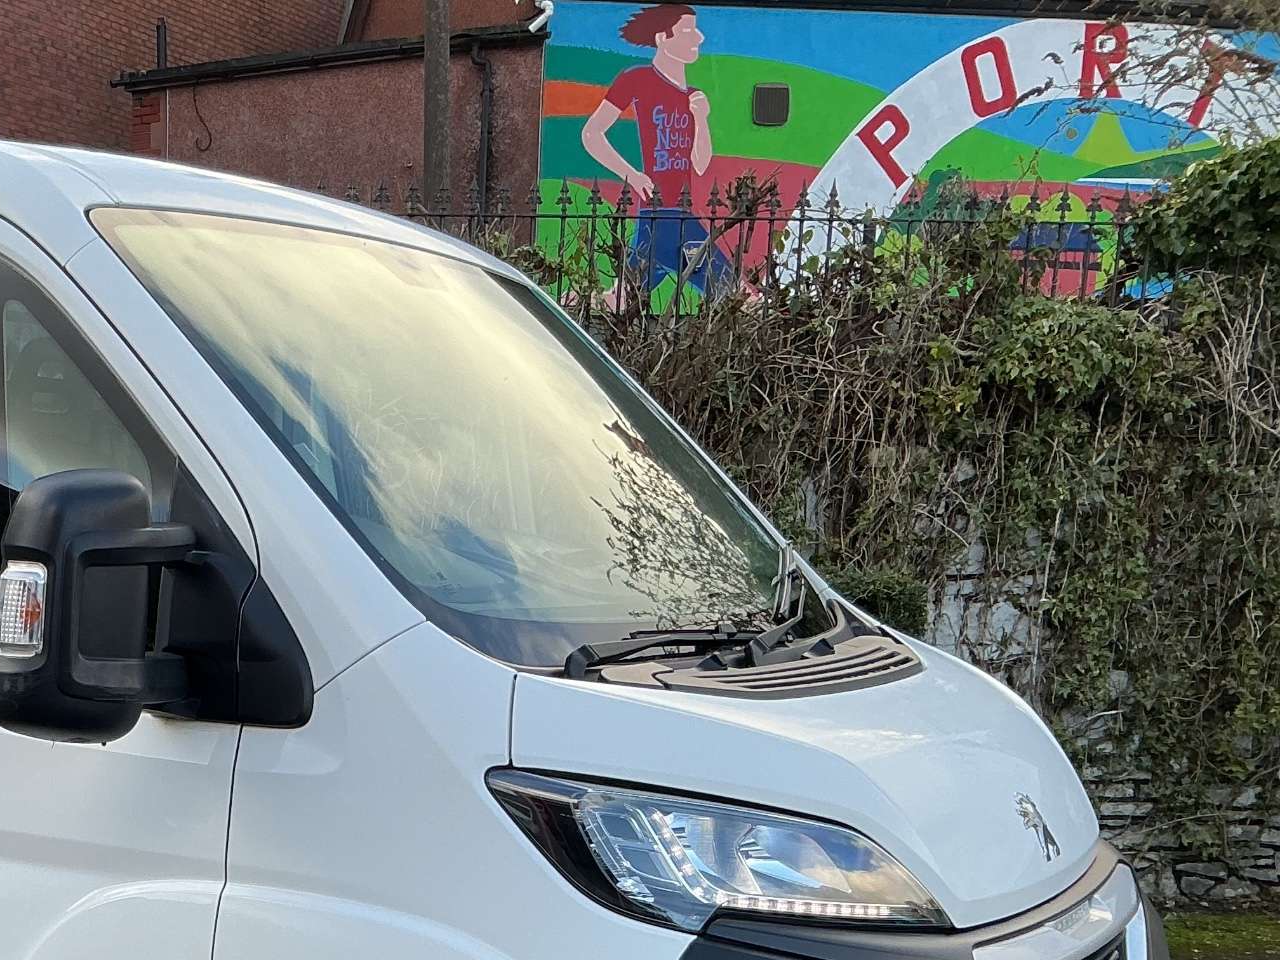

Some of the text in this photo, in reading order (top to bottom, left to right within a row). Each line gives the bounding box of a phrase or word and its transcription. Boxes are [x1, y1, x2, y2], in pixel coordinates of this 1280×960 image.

[652, 104, 689, 130] Guto
[654, 127, 691, 150] Nyth
[653, 150, 689, 172] Brân
